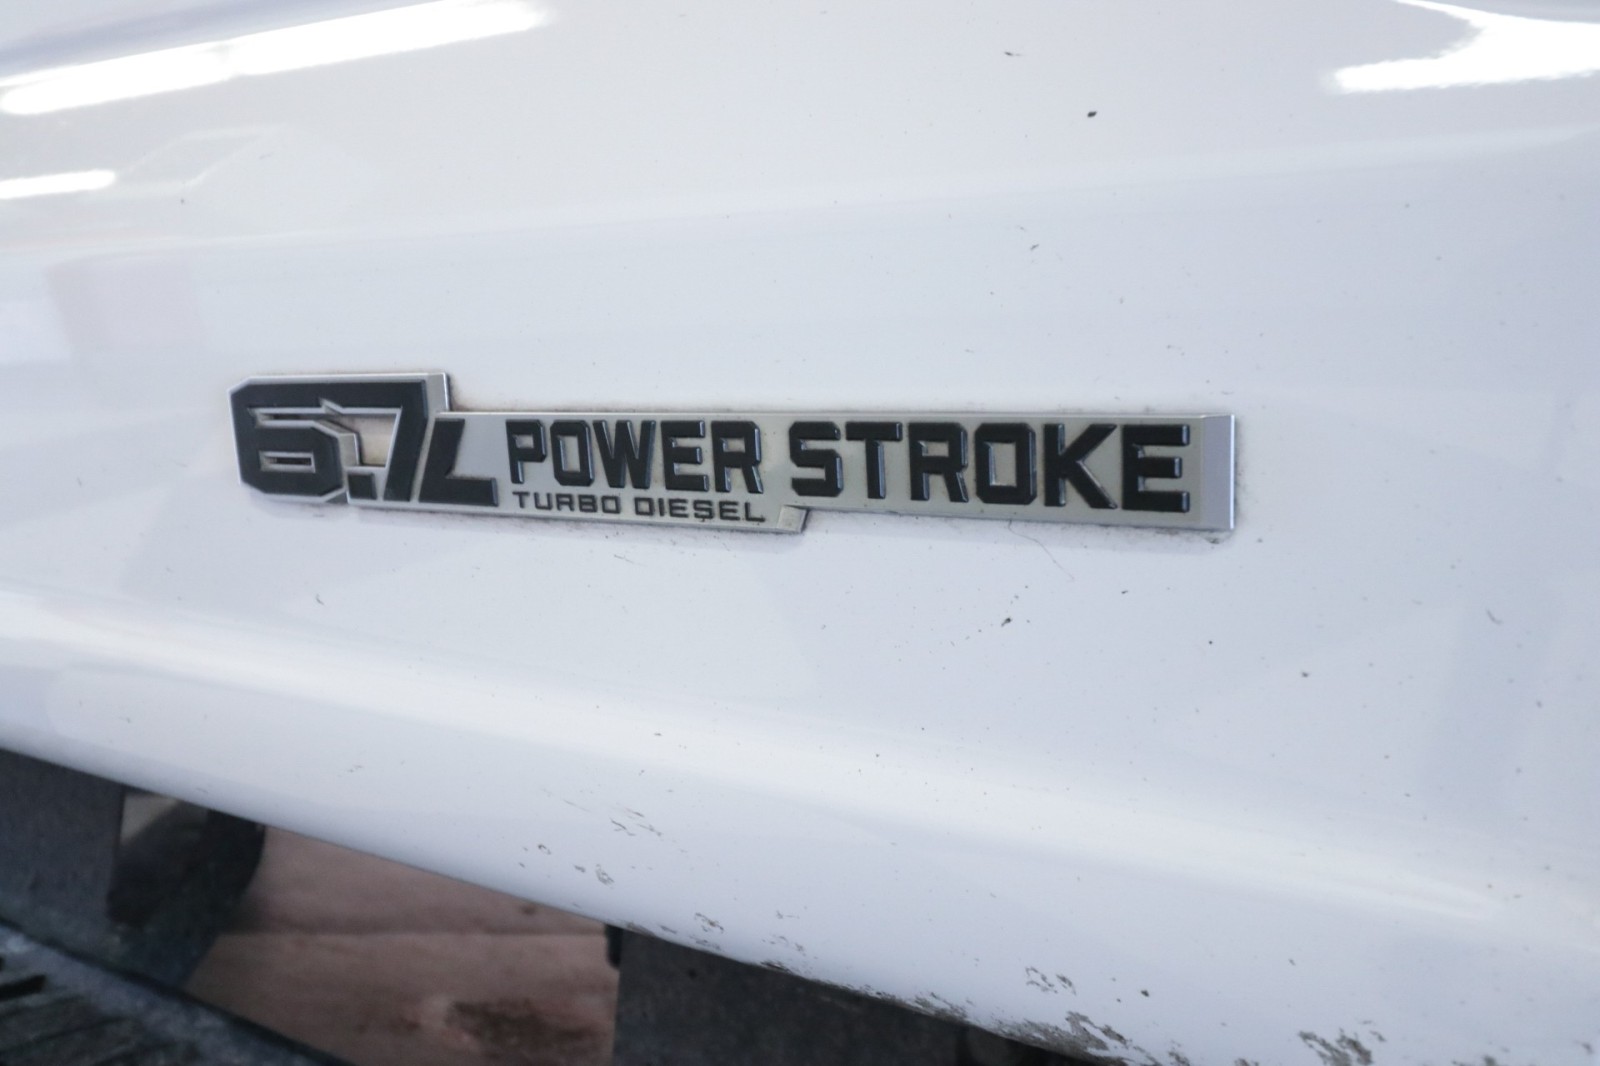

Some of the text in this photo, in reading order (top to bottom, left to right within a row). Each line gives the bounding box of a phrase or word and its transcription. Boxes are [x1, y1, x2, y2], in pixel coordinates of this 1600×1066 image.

[230, 380, 1190, 513] 6.7L POWER STROKE
[512, 491, 766, 522] TURBO DIESEL
